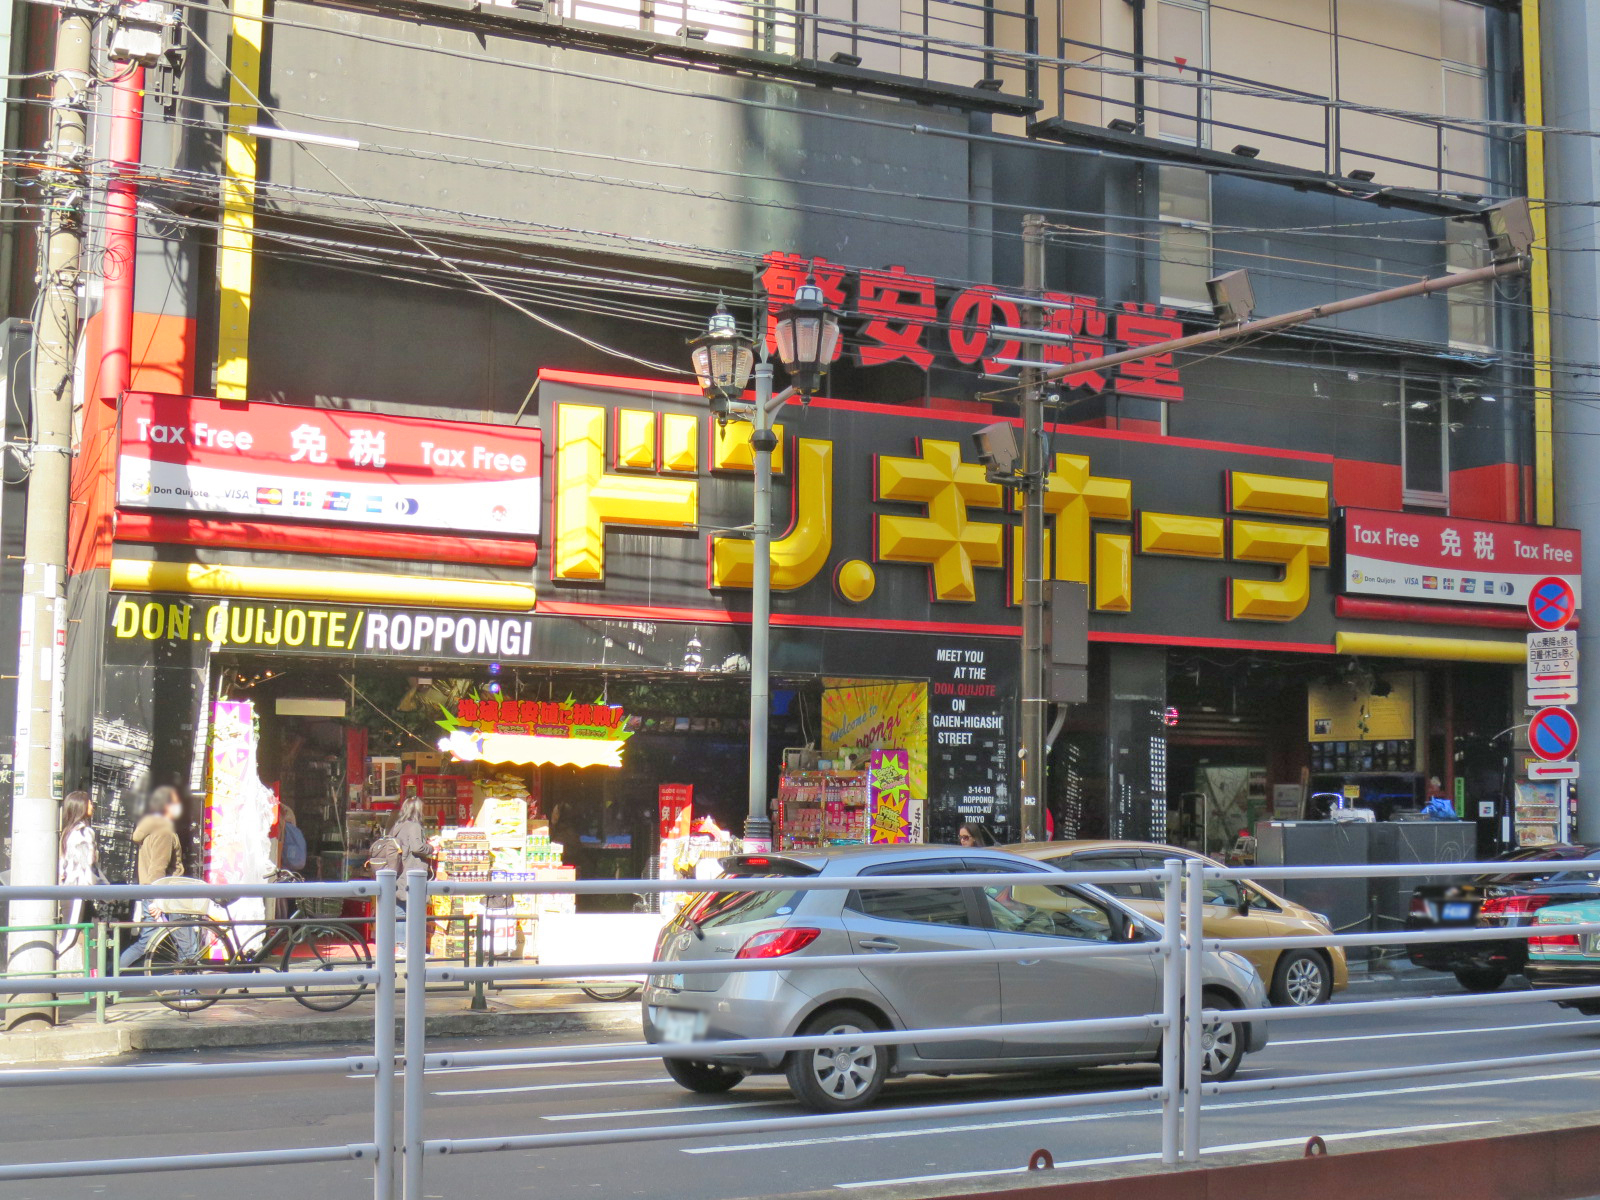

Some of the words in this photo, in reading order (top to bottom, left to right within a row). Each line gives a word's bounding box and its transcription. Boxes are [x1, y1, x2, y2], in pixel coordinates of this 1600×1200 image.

[137, 418, 185, 444] Tax
[194, 422, 253, 450] Free
[421, 442, 465, 468] Tax
[473, 446, 526, 472] Free
[153, 486, 172, 495] Don
[175, 487, 209, 498] Quijote
[225, 489, 249, 500] VISA
[1353, 525, 1381, 545] Tax
[1385, 528, 1420, 548] Free
[1514, 540, 1541, 560] Tax
[1543, 544, 1573, 563] Free
[1364, 575, 1376, 583] Don
[1404, 577, 1419, 585] VISA
[937, 649, 962, 661] MEET
[965, 650, 984, 663] YOU
[954, 667, 966, 679] AT
[969, 668, 986, 680] THE
[934, 683, 996, 696] DON.QUIJOTE
[952, 699, 966, 711] ON
[933, 715, 1002, 728] GAIEN-HIGASHI
[938, 732, 973, 745] STREET
[968, 786, 991, 794] 3-14-10
[963, 796, 994, 804] ROPPONGI
[958, 806, 992, 814] MINATO-KU
[965, 815, 985, 823] TOKYO
